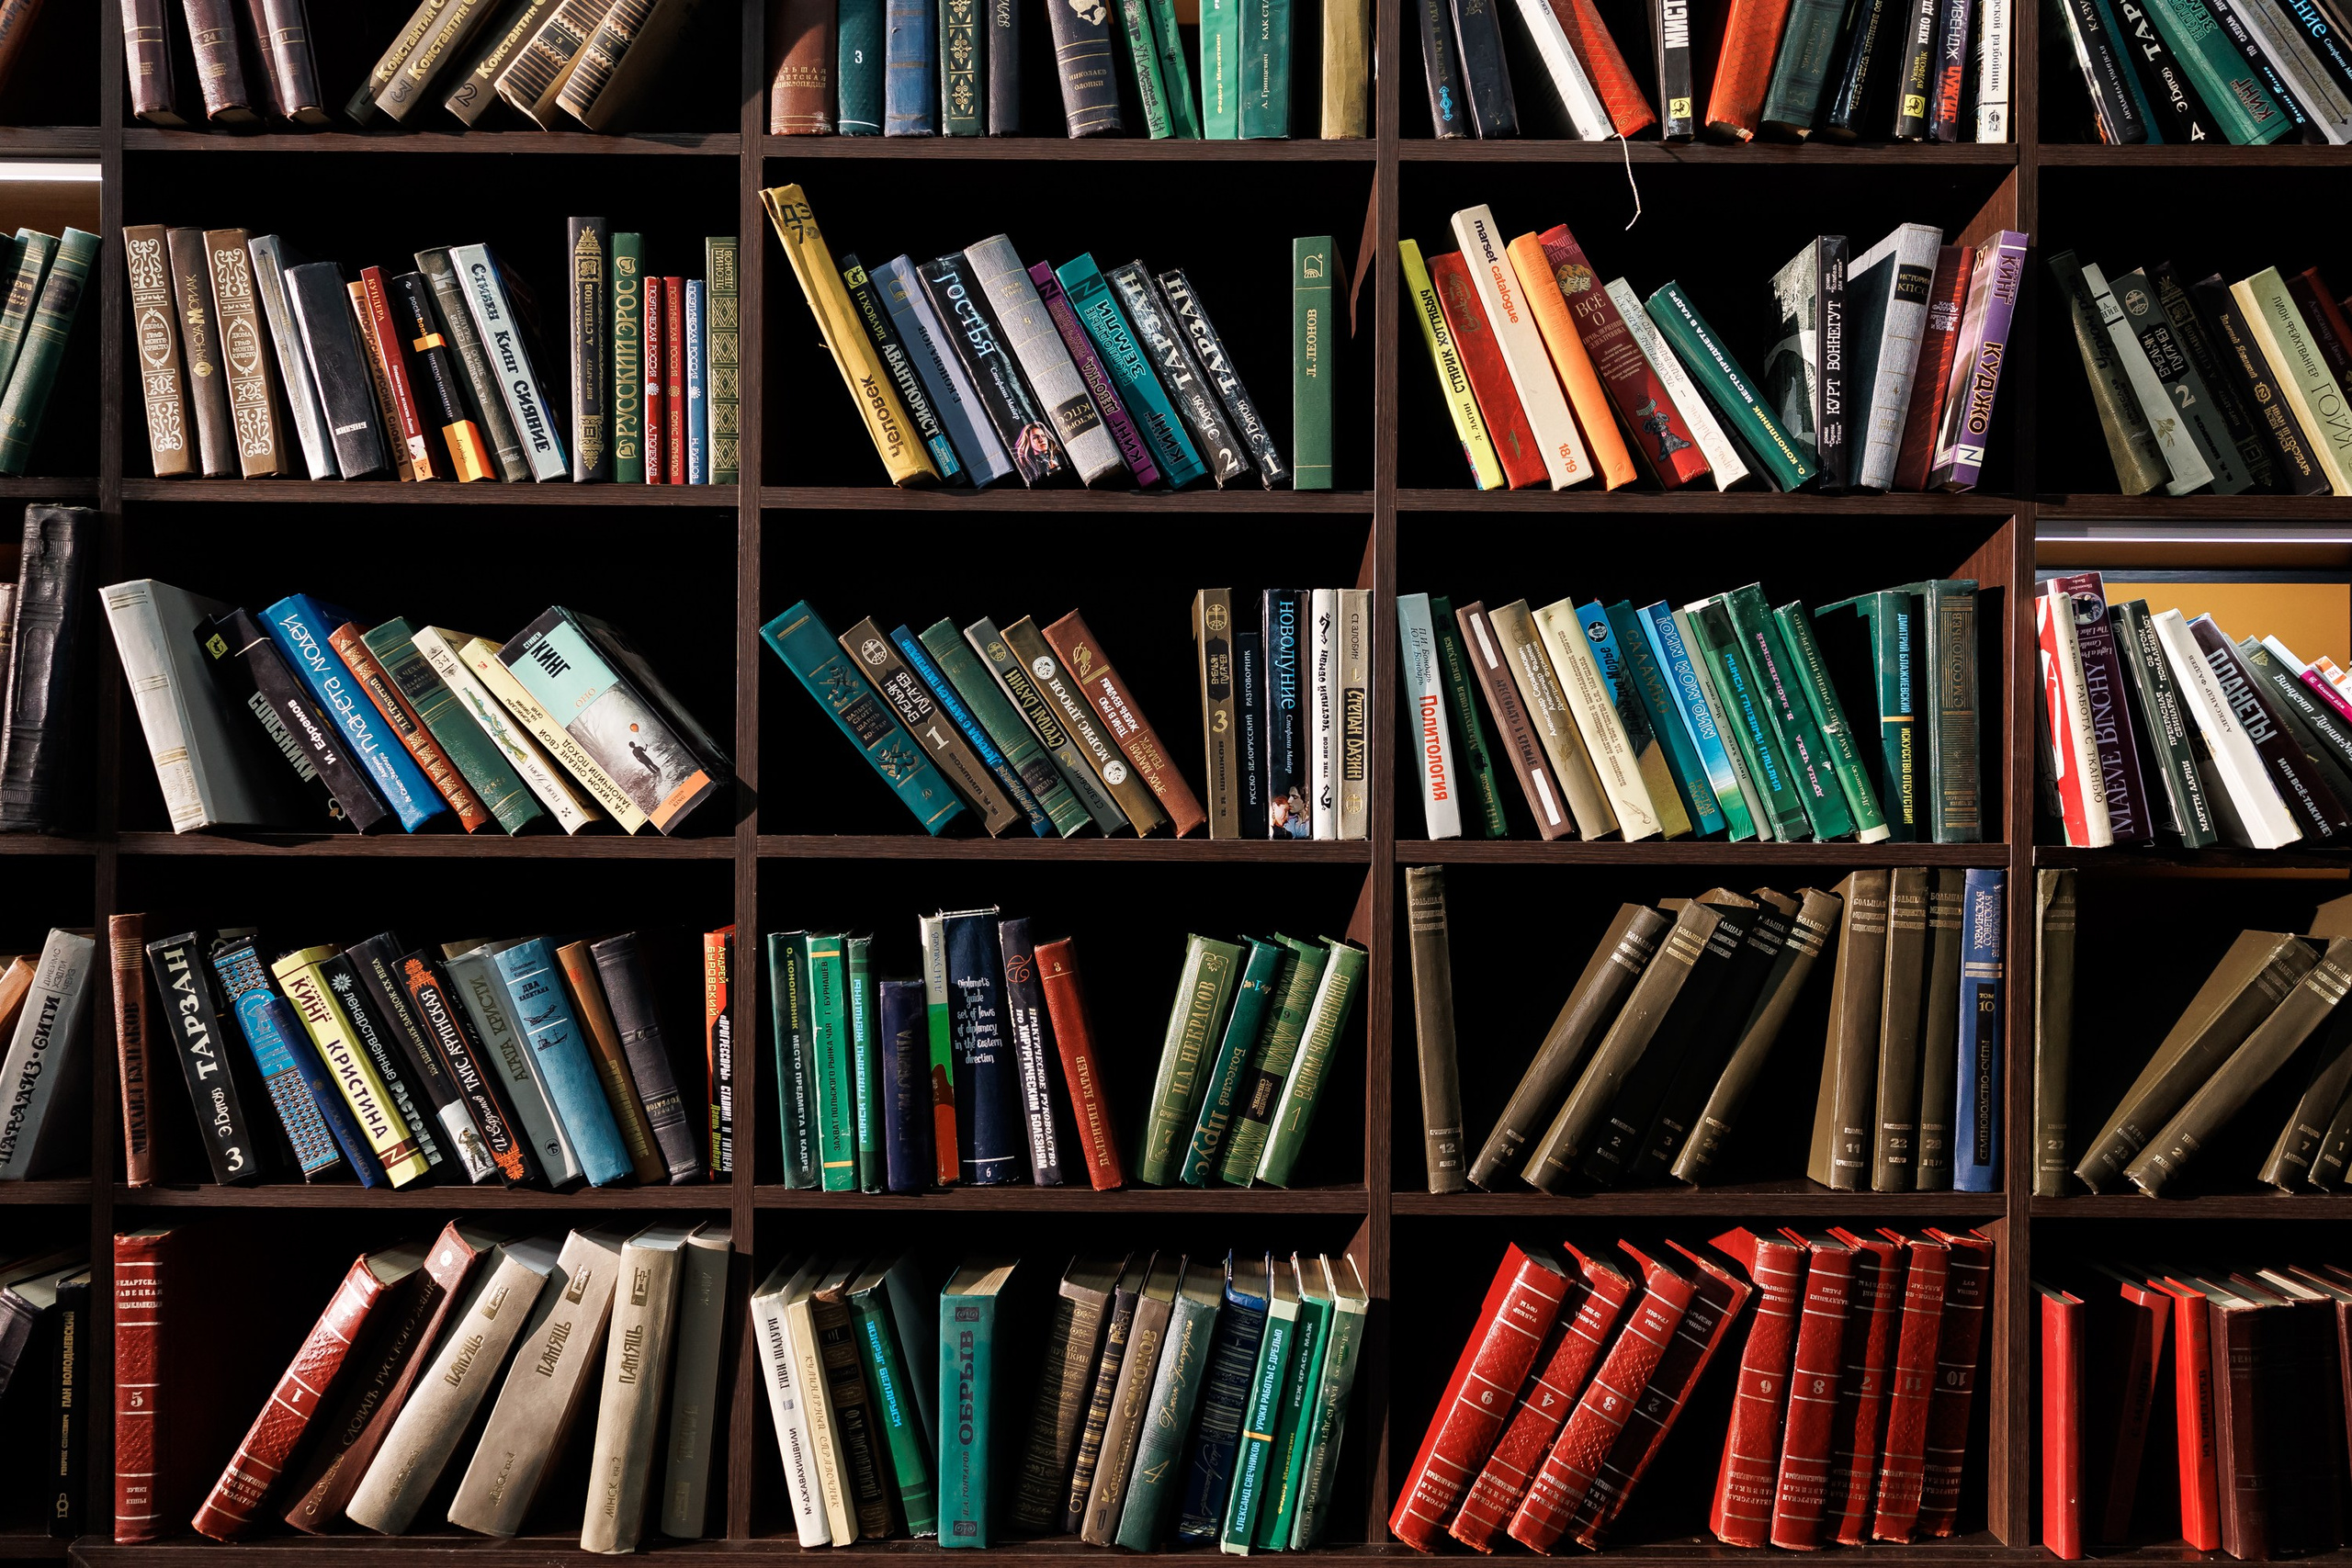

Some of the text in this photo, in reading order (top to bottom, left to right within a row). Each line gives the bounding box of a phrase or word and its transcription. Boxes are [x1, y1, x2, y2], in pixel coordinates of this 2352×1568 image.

[376, 6, 436, 83] Константин
[407, 5, 469, 81] Константин
[476, 5, 538, 79] Константин
[854, 51, 863, 63] 3
[1261, 20, 1270, 40] КАК
[1918, 16, 1930, 45] КИНО
[2226, 17, 2257, 57] ПО СЛЕДАМ
[1069, 69, 1107, 82] НИКОЛАЕВ
[1917, 51, 1928, 89] ВУЛФОЛК
[1992, 33, 2003, 92] разбойник
[2098, 44, 2118, 80] УЛИЦКАЯ
[2111, 80, 2133, 120] ЛЮДМИЛА
[2190, 121, 2206, 141] 4
[368, 278, 385, 321] КУНДЕРА
[1474, 220, 1520, 324] marset catalogue
[232, 331, 252, 339] ДЮМА
[616, 278, 638, 437] РУССКИЙ ЭРОС
[649, 285, 657, 377] ПОЭТИЧЕСКАЯ РОССИЯ
[670, 287, 678, 377] ПОЭТИЧЕСКАЯ РОССИЯ
[1120, 271, 1193, 391] ТАРЗАН
[1166, 277, 1236, 395] ТАРЗАН
[1419, 288, 1465, 393] СТАРИК ХОТТАБЫЧ
[1826, 300, 1841, 414] КУРТ ВОННЕГУТ
[2142, 333, 2171, 378] ЕМЕЛЬЯН
[2271, 296, 2319, 378] ЛИОН ФЕЙХТВАНГЕР
[494, 330, 518, 373] КИНГ
[514, 380, 550, 453] СИЯНИЕ
[883, 344, 940, 437] АВАНТЮРИСТ
[988, 366, 1022, 421] Стефани Майер
[1968, 342, 2003, 435] КУДЖО
[2175, 385, 2196, 409] 2
[1218, 448, 1238, 472] 2
[1558, 443, 1577, 473] 18/19
[1752, 405, 1805, 475] О. КОНОПЛЯНИК
[523, 631, 542, 649] СТИВЕН
[530, 639, 571, 679] КИНГ
[574, 687, 597, 709] ОНО
[885, 681, 920, 723] ЕМЕЛЬЯН
[1244, 650, 1252, 706] РАЗГОВОРНИК
[1444, 636, 1479, 751] Малахитовая шкатулка
[1515, 645, 1558, 738] Александр Серафимович
[1530, 639, 1566, 710] Дмитрий Фурманов
[1625, 628, 1670, 715] САЛАМБО
[1756, 630, 1794, 721] В. ВАСИЛЕВСКИЙ
[2142, 615, 2183, 738] СВИНАРКА ПОМАЛКИВАЮТ
[2188, 652, 2233, 735] АЛЕКСАНДР ФАДЕЕВ
[2206, 648, 2278, 746] ПЛАНЕТЫ
[287, 699, 337, 765] И. Ефремов
[846, 699, 872, 722] ВАЛЬТЕР
[1048, 677, 1112, 762] МОРИС ДРЮОН
[1099, 674, 1140, 733] ЖИЗНЬ ВЗАЙМЫ
[1212, 710, 1228, 732] 3
[247, 691, 318, 784] СОЮЗНИКИ
[925, 726, 949, 750] 1
[1419, 694, 1448, 802] Политология
[1795, 734, 1825, 798] ДУША ЧЕХА
[2085, 661, 2135, 834] MAEVE BINCHY
[1901, 727, 1914, 825] ИСКУССТВО ОТСУТСТВИЯ
[2180, 758, 2211, 831] МАРТТИ ЛАРНИ
[1678, 925, 1706, 946] БОЛЬШАЯ
[1973, 889, 1985, 950] УКРАИНСКАЯ
[43, 948, 62, 987] ДЖЕЙМС
[52, 961, 68, 987] ХЭДЛИ
[707, 946, 718, 1017] БУРОВСКИЙ
[717, 945, 727, 984] АНДРЕЙ
[164, 947, 218, 1080] ТАРЗАН
[469, 975, 529, 1083] АГАТА КРИСТИ
[1295, 973, 1351, 1100] ВАДИМ КОЖЕВНИКОВ
[1979, 1000, 1995, 1012] 10
[325, 1039, 389, 1140] КРИСТИНА
[786, 946, 809, 1172] О. КОНОПЛЯНИК МЕСТО ПРЕДМЕТА В КАДРЕ
[1015, 1007, 1048, 1169] ПО ХИРУРГИЧЕСКИМ БОЛЕЗНЯМ
[1028, 1007, 1057, 1168] ПРАКТИЧЕСКОЕ РУКОВОДСТВО
[1076, 1055, 1110, 1167] ВАЛЕНТИН КАТАЕВ
[1193, 1046, 1248, 1177] Болеслав Прус
[225, 1146, 243, 1172] 3
[1439, 1143, 1455, 1154] 12
[1501, 1143, 1514, 1157] 14
[1846, 1143, 1860, 1154] 11
[2048, 1140, 2065, 1150] 27
[62, 1311, 74, 1408] ПАН ВОЛОДЫЕВСКИЙ
[443, 1334, 484, 1389] ПАМЯЦЬ
[536, 1321, 572, 1380] ПАМЯЦЬ
[618, 1324, 644, 1385] ПАМЯЦЬ
[1292, 1321, 1314, 1407] РЕЖ КРАСЬ МАЖ
[1946, 1370, 1966, 1385] 10
[130, 1392, 144, 1408] 5
[291, 1387, 304, 1403] 1
[343, 1318, 415, 1447] СЛОВАРЬ РУССКОГО
[957, 1330, 975, 1445] ОБРЫВ
[1480, 1390, 1495, 1405] 9
[1540, 1392, 1555, 1408] 4
[1602, 1395, 1617, 1412] 3
[1759, 1379, 1772, 1394] 6
[1813, 1379, 1826, 1394] 8
[805, 1355, 840, 1507] КУЛИНАРНЫЙ СПРАВОЧНИК
[1143, 1459, 1170, 1485] 4
[1235, 1440, 1261, 1532] АЛЕКСАНД СВЕЧНИКОВ
